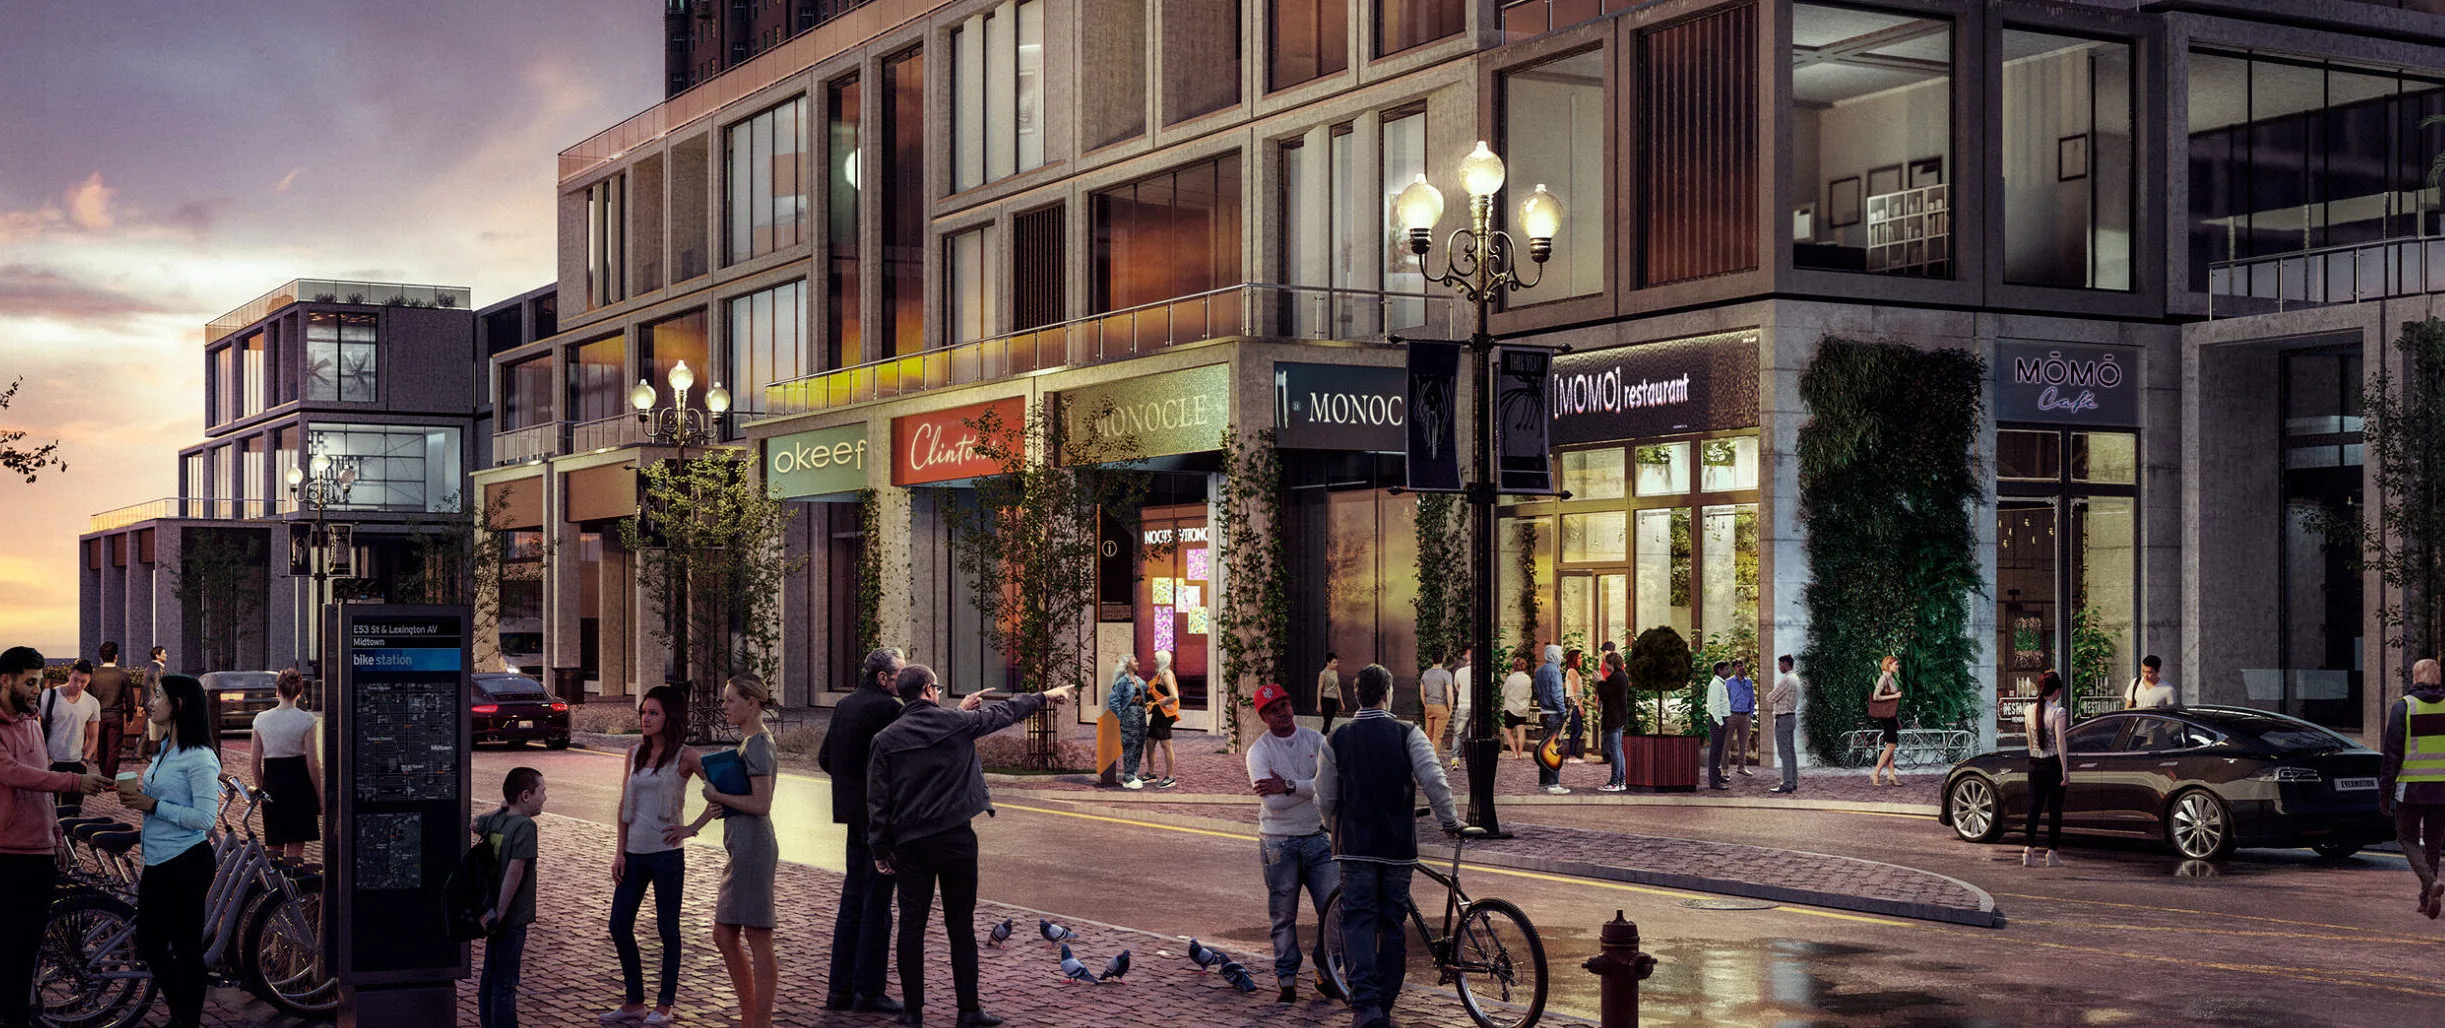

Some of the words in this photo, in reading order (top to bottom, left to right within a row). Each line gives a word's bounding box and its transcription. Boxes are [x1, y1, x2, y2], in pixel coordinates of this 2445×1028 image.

[1624, 373, 1689, 409] restaurant
[353, 625, 369, 634] E53
[371, 625, 379, 634] St
[381, 625, 387, 634] &
[388, 625, 425, 635] Lexington
[427, 625, 438, 634] AV
[353, 638, 385, 646] Midtown
[353, 654, 374, 665] bike
[376, 655, 412, 665] station
